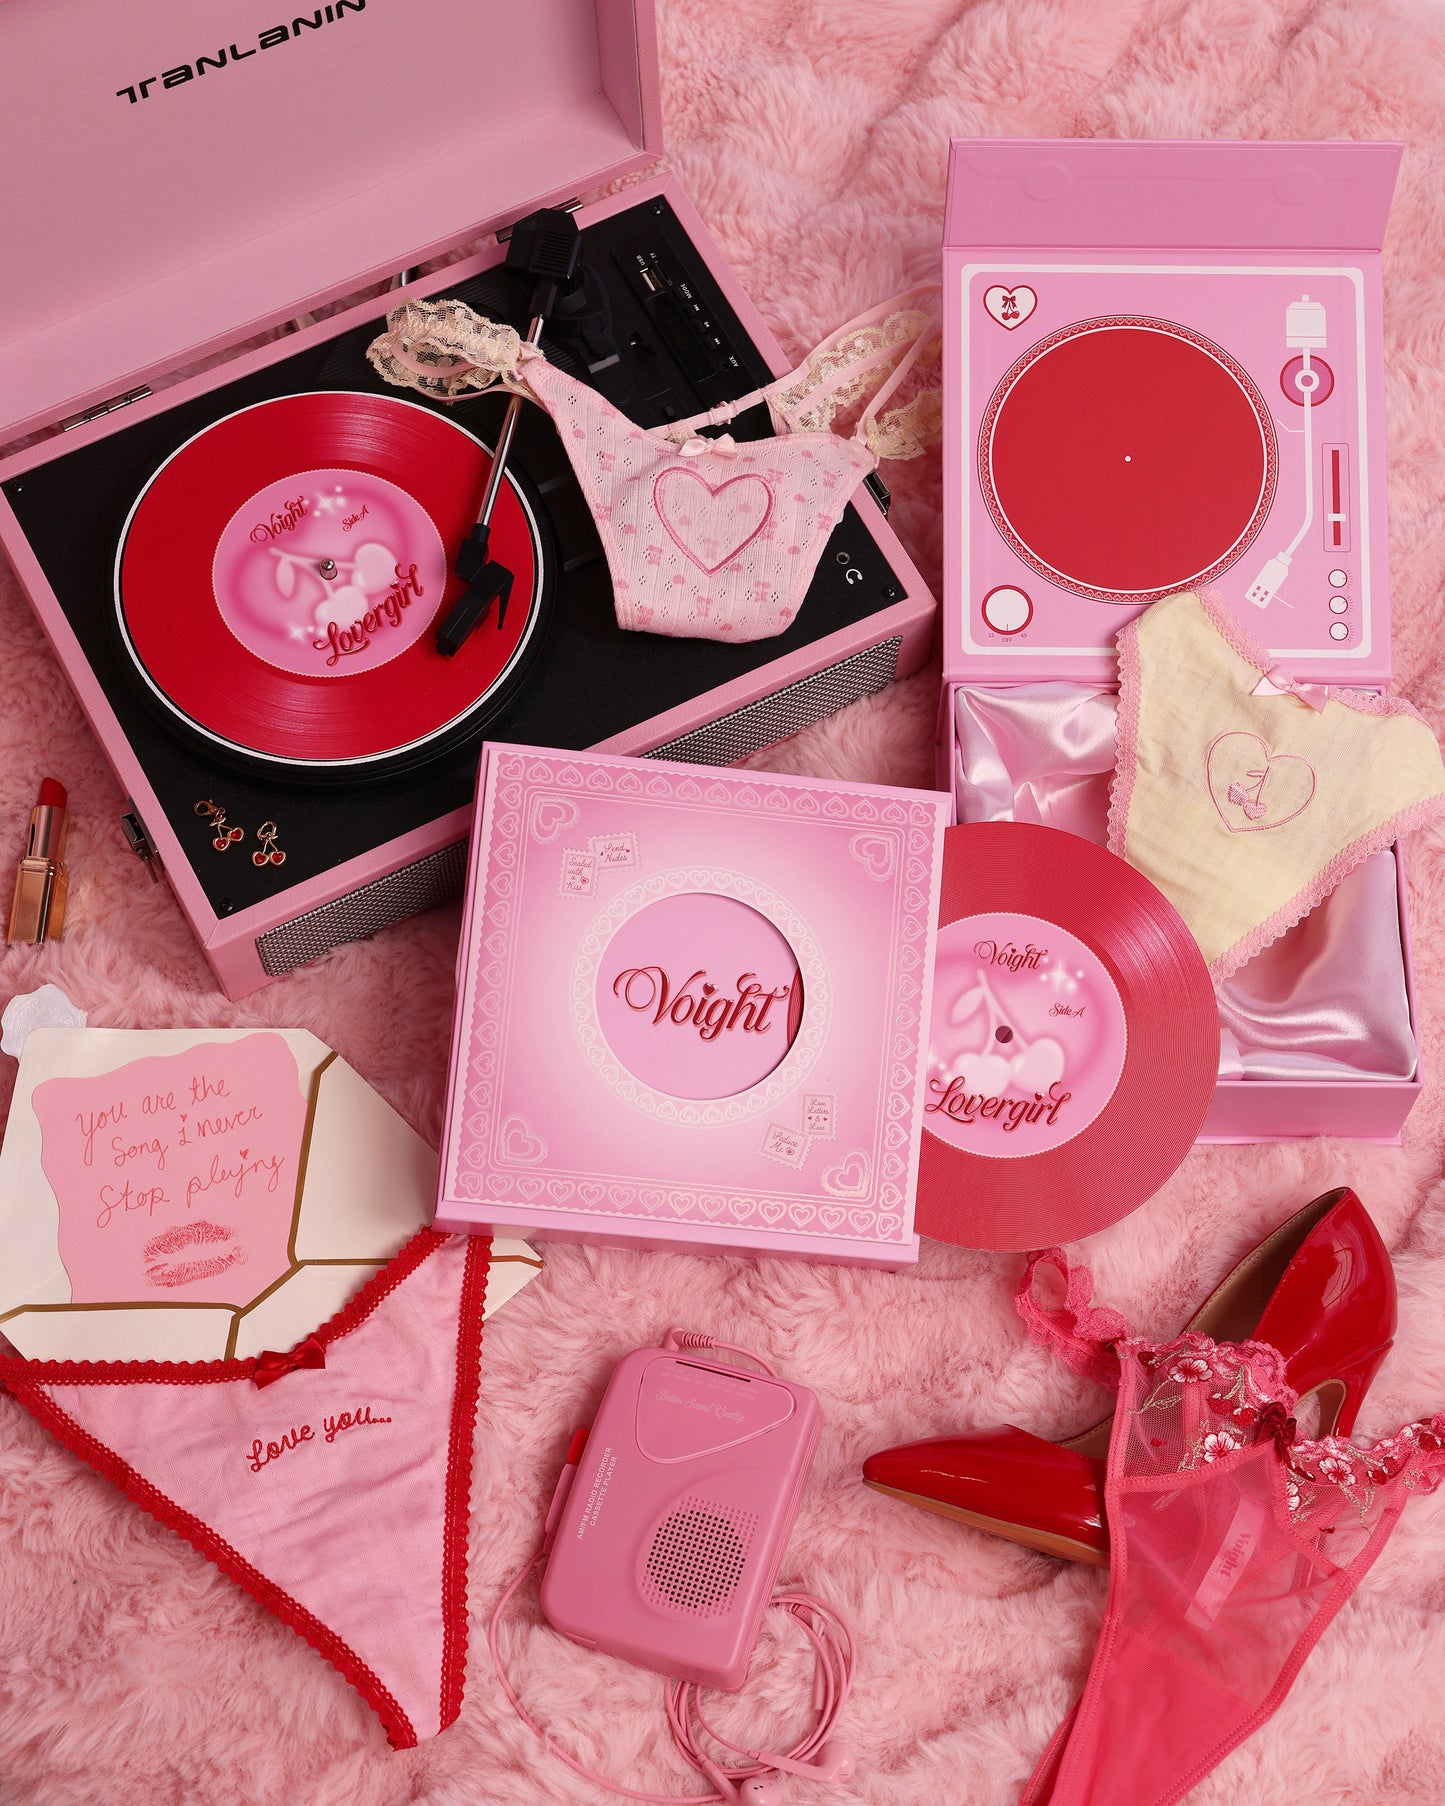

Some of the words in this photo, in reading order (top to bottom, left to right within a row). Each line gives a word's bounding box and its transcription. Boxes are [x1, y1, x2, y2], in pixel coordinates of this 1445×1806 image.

[680, 283, 693, 299] MODE
[729, 355, 739, 367] AUX
[249, 495, 308, 543] Voight
[312, 562, 425, 667] Lovergirl
[604, 853, 628, 863] Nudes
[974, 939, 1048, 973] Voight
[613, 966, 790, 1041] Voight
[142, 1091, 177, 1115] are
[188, 1075, 231, 1106] the
[924, 1076, 1072, 1134] Lovergirl
[197, 1105, 263, 1138] never
[769, 1141, 784, 1152] Me
[246, 1425, 316, 1472] Love
[584, 1489, 598, 1514] RADIO
[593, 1446, 612, 1489] RECORDER
[589, 1487, 607, 1526] CASSETTE
[602, 1456, 618, 1486] PLAYER
